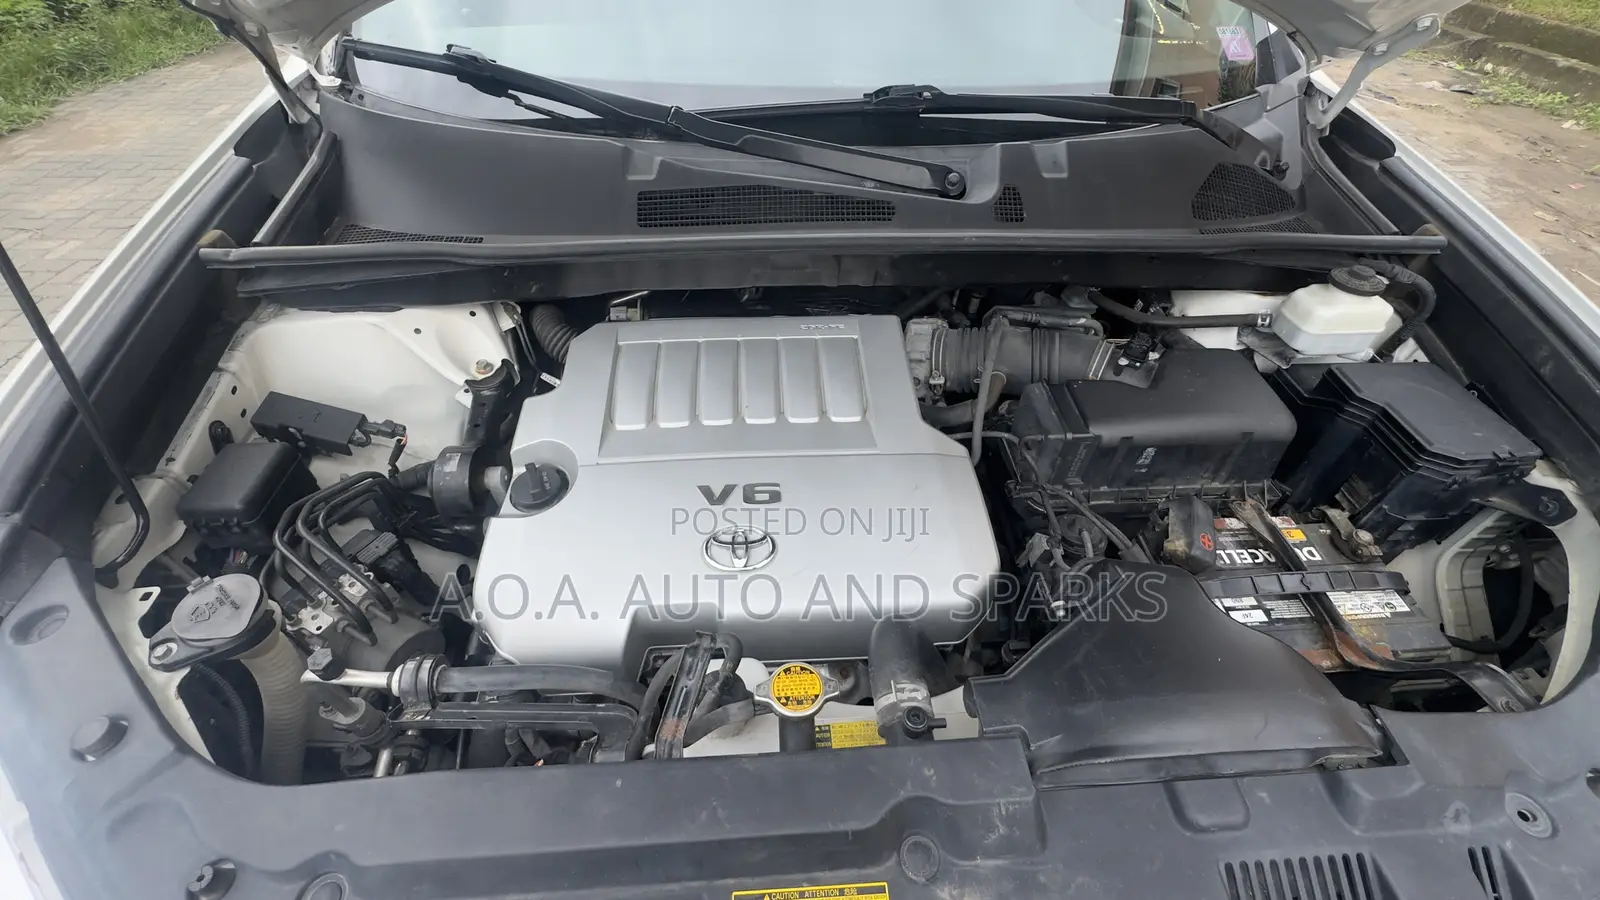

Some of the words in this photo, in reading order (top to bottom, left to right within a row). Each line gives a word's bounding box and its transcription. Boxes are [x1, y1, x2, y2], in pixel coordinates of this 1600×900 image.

[697, 482, 782, 505] V6
[771, 891, 799, 900] CAUTION
[804, 888, 839, 898] ATTENTION
